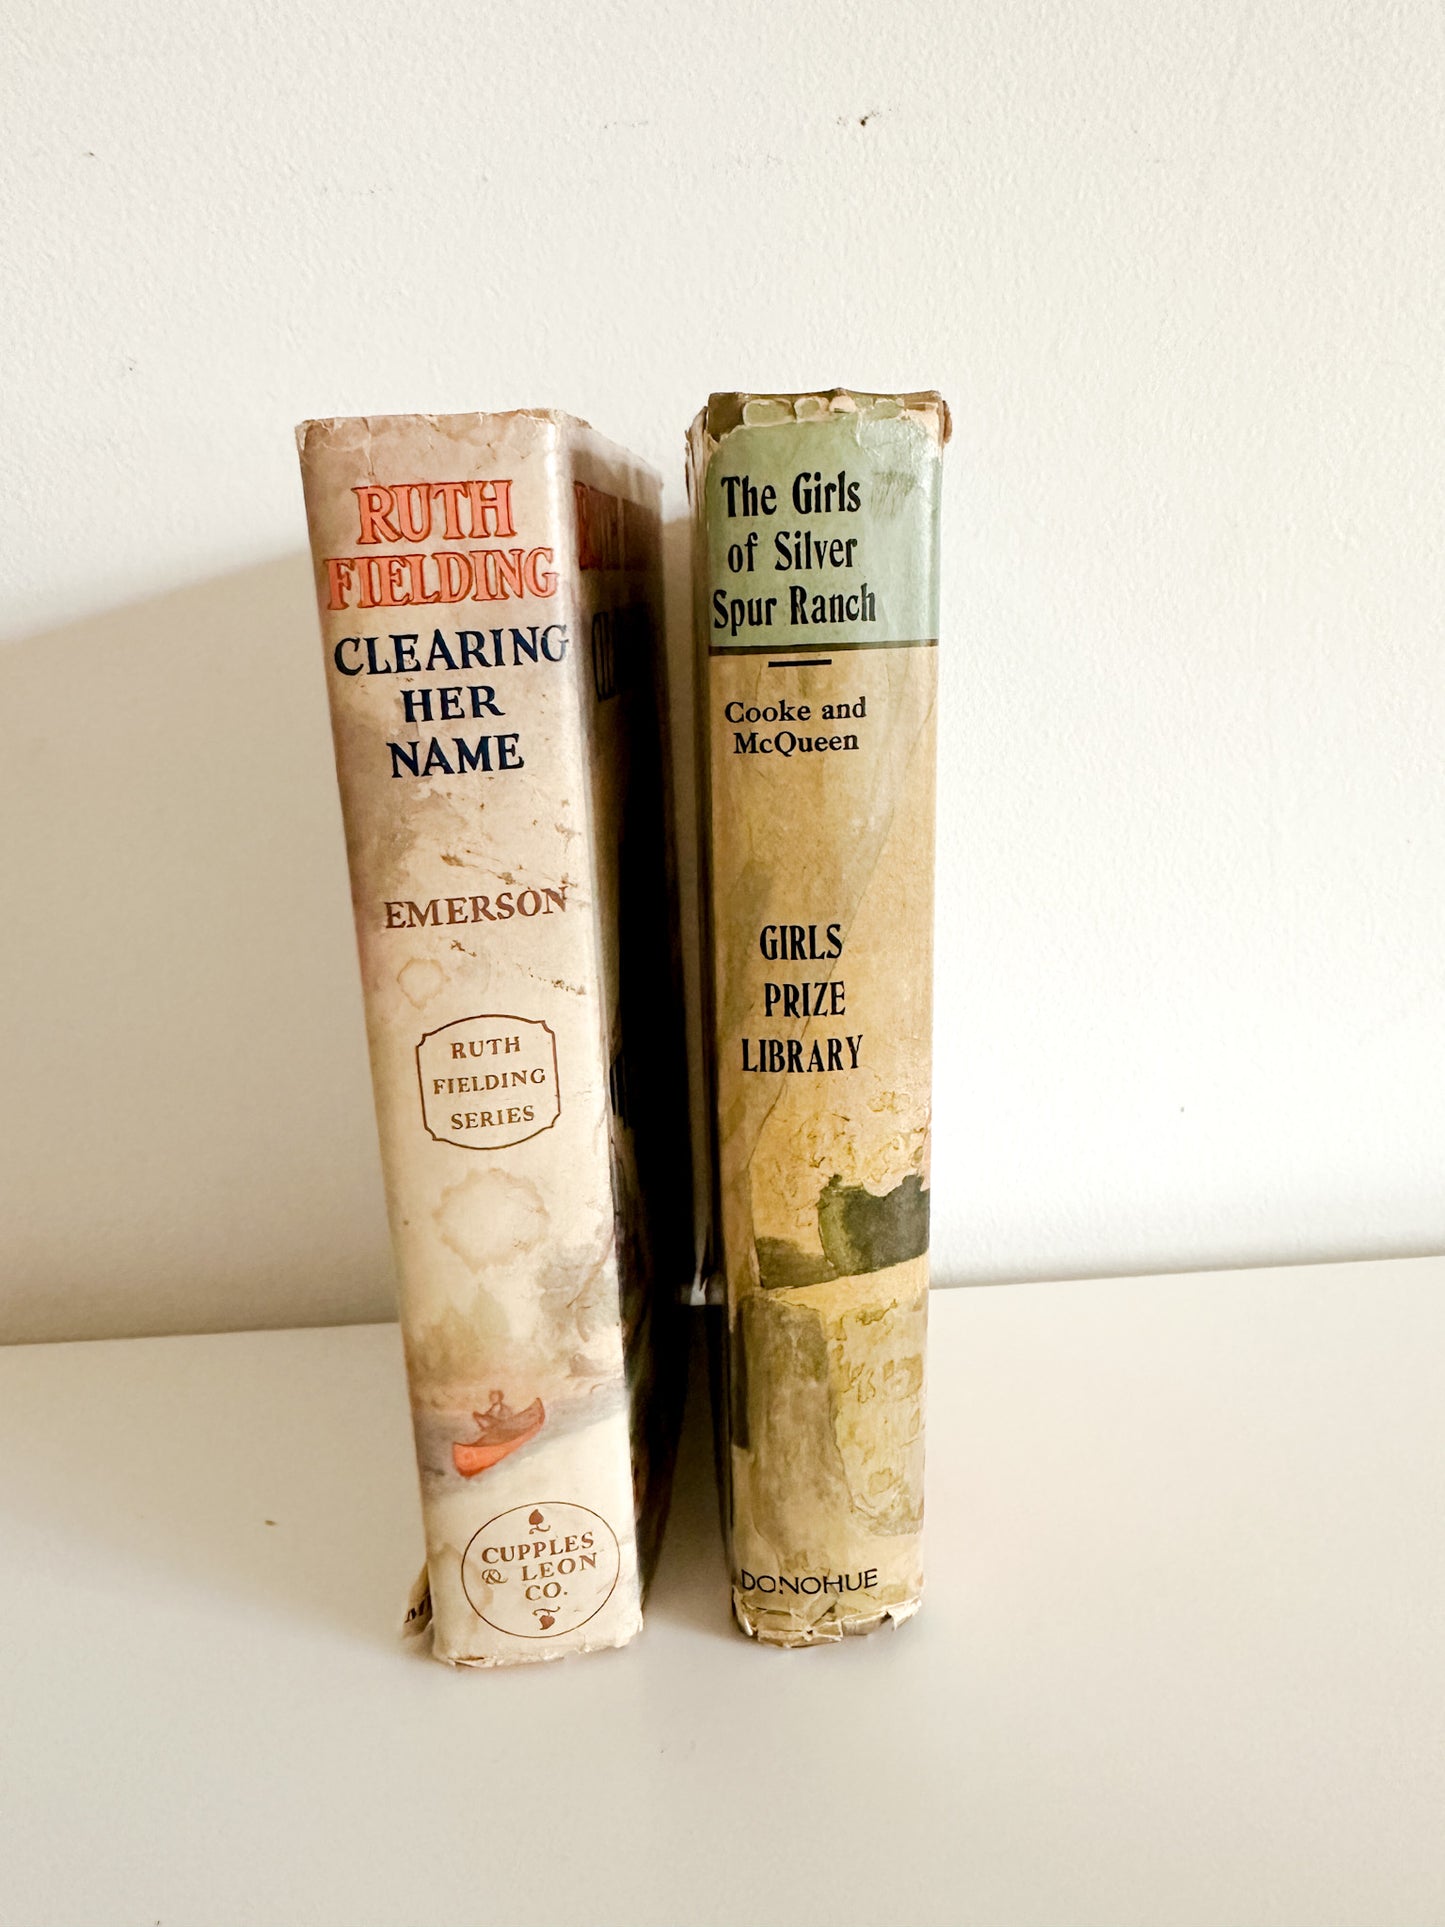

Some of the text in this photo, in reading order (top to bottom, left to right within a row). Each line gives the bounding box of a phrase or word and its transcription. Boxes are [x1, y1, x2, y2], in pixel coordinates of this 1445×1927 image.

[351, 479, 517, 545] RUTH
[720, 470, 861, 517] The Girls
[727, 530, 858, 572] of Silver
[323, 547, 559, 610] FIELDING
[712, 582, 876, 636] Spur Ranch
[334, 624, 570, 676] CLEARING
[400, 685, 506, 723] HER
[724, 696, 867, 723] Cooke and
[386, 733, 525, 778] NAME
[733, 731, 860, 757] McQueen
[383, 885, 568, 929] EMERSON
[759, 923, 843, 961] GIRLS
[764, 980, 846, 1018] PRIZE
[451, 1036, 521, 1060] RUTH
[741, 1034, 863, 1073] LIBRARY
[432, 1068, 546, 1095] FIELDING
[450, 1104, 535, 1131] SERIES
[481, 1531, 595, 1565] CUPPLES
[481, 1552, 598, 1585] & LEON
[741, 1568, 879, 1595] DONOHUE
[525, 1581, 568, 1601] CO.
